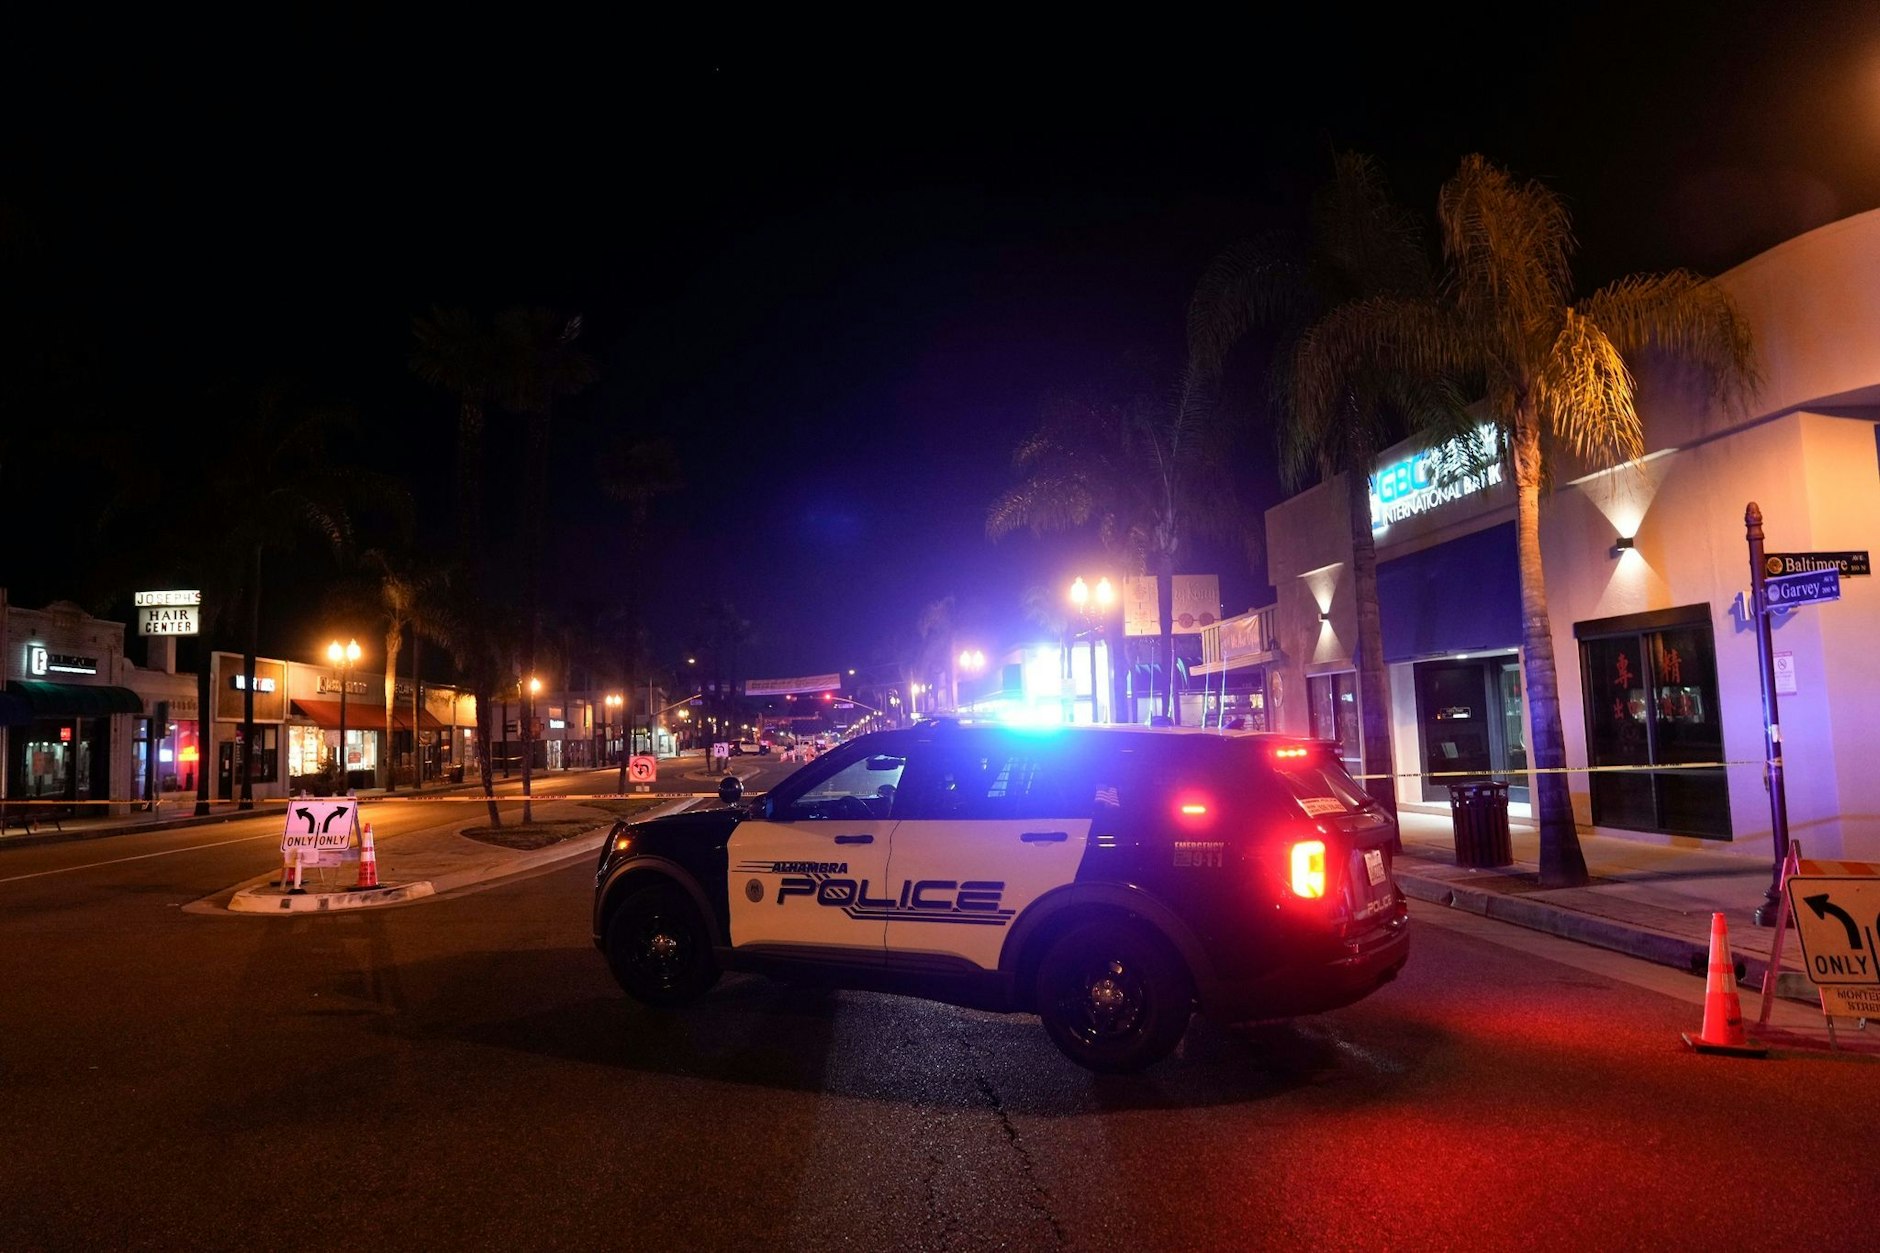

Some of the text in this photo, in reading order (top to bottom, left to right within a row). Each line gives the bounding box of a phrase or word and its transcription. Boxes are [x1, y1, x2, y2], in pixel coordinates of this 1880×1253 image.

[1377, 453, 1430, 503] GBC
[1383, 462, 1502, 527] INTERNATIONAL BANK
[1785, 557, 1848, 572] Baltimore
[1781, 582, 1820, 598] Garvey
[137, 592, 202, 604] JOSEPH'S
[149, 610, 189, 621] HAIR
[145, 621, 191, 633] CENTER
[287, 835, 346, 847] ONLY ONLY
[1174, 841, 1225, 850] EMERGENCY
[772, 863, 848, 874] ALHAMBRA
[776, 878, 1005, 910] POLICE
[1367, 894, 1393, 915] POLICE
[1815, 955, 1867, 975] ONLY
